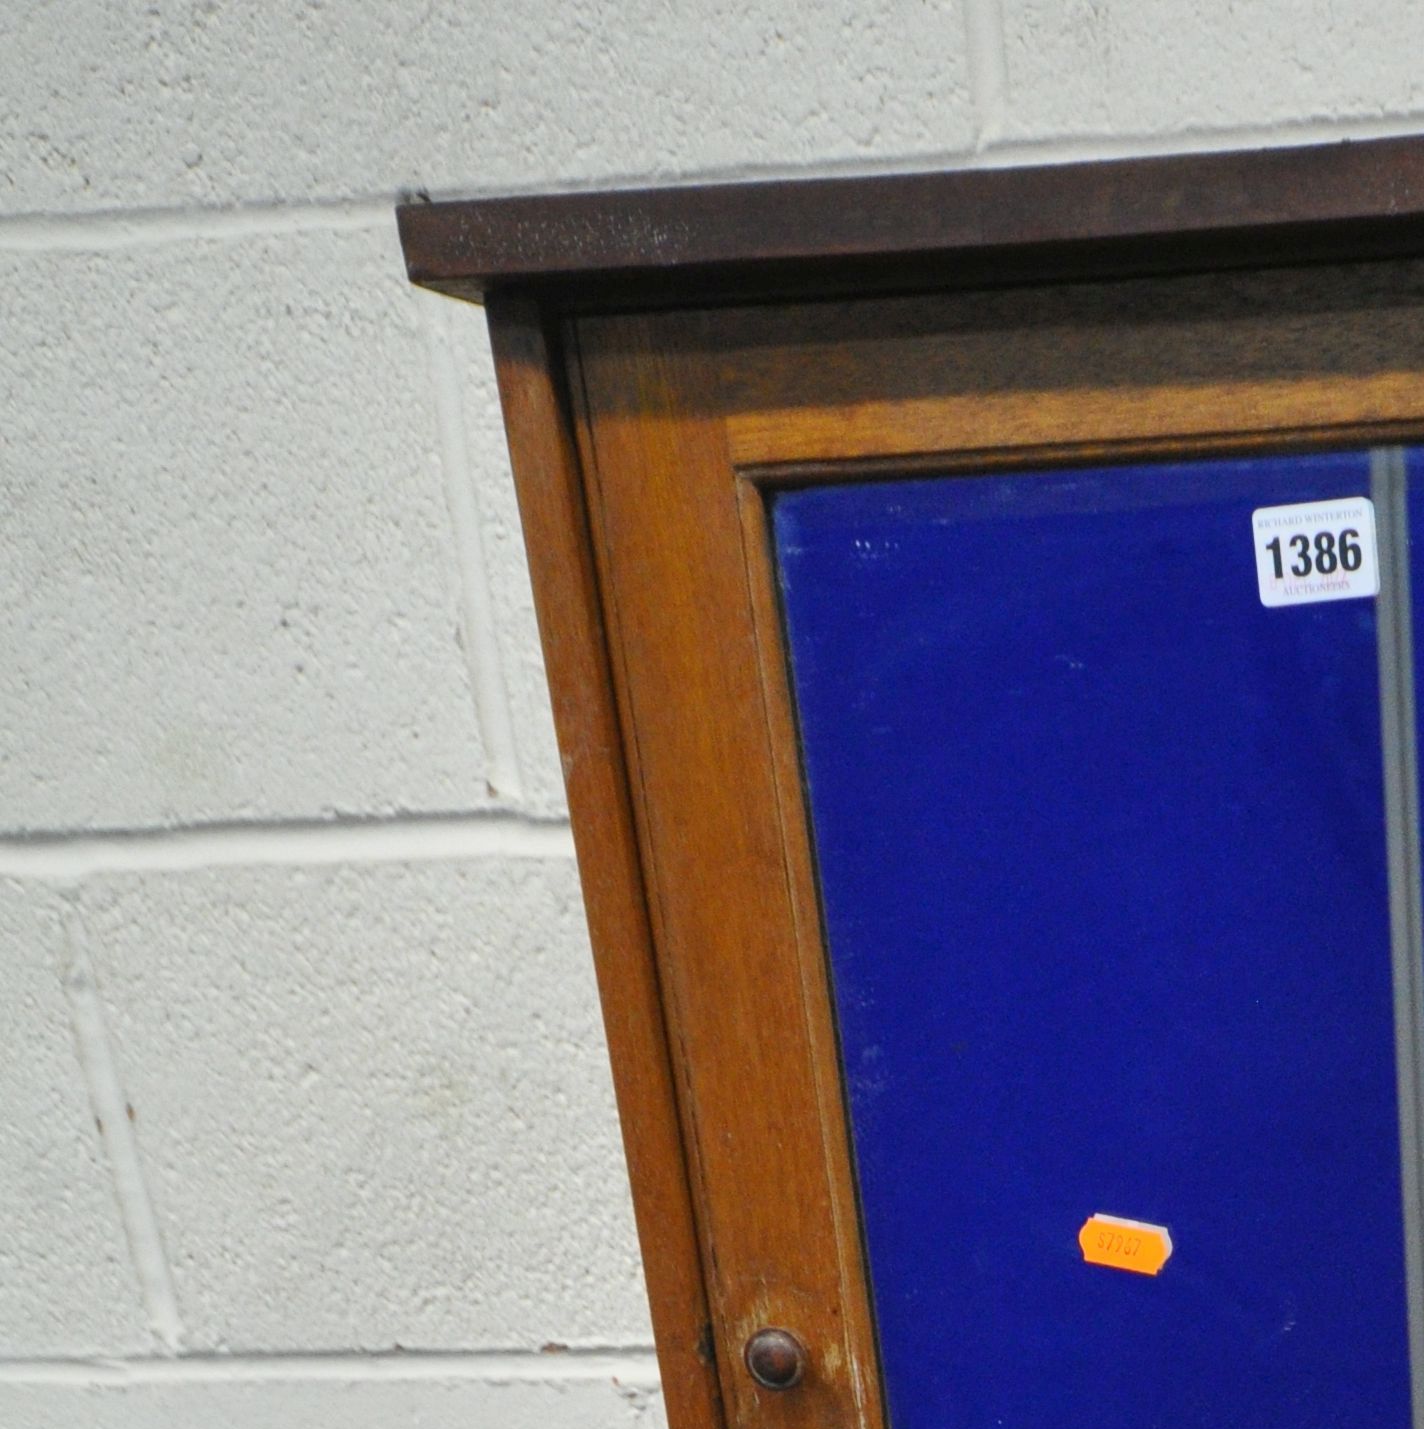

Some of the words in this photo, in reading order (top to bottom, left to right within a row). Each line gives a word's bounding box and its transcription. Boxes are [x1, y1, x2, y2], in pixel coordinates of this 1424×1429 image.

[1258, 515, 1303, 529] RICHARD
[1304, 508, 1363, 523] WINTERTON
[1265, 528, 1362, 579] 1386
[1283, 580, 1351, 597] AUCTIONEERS
